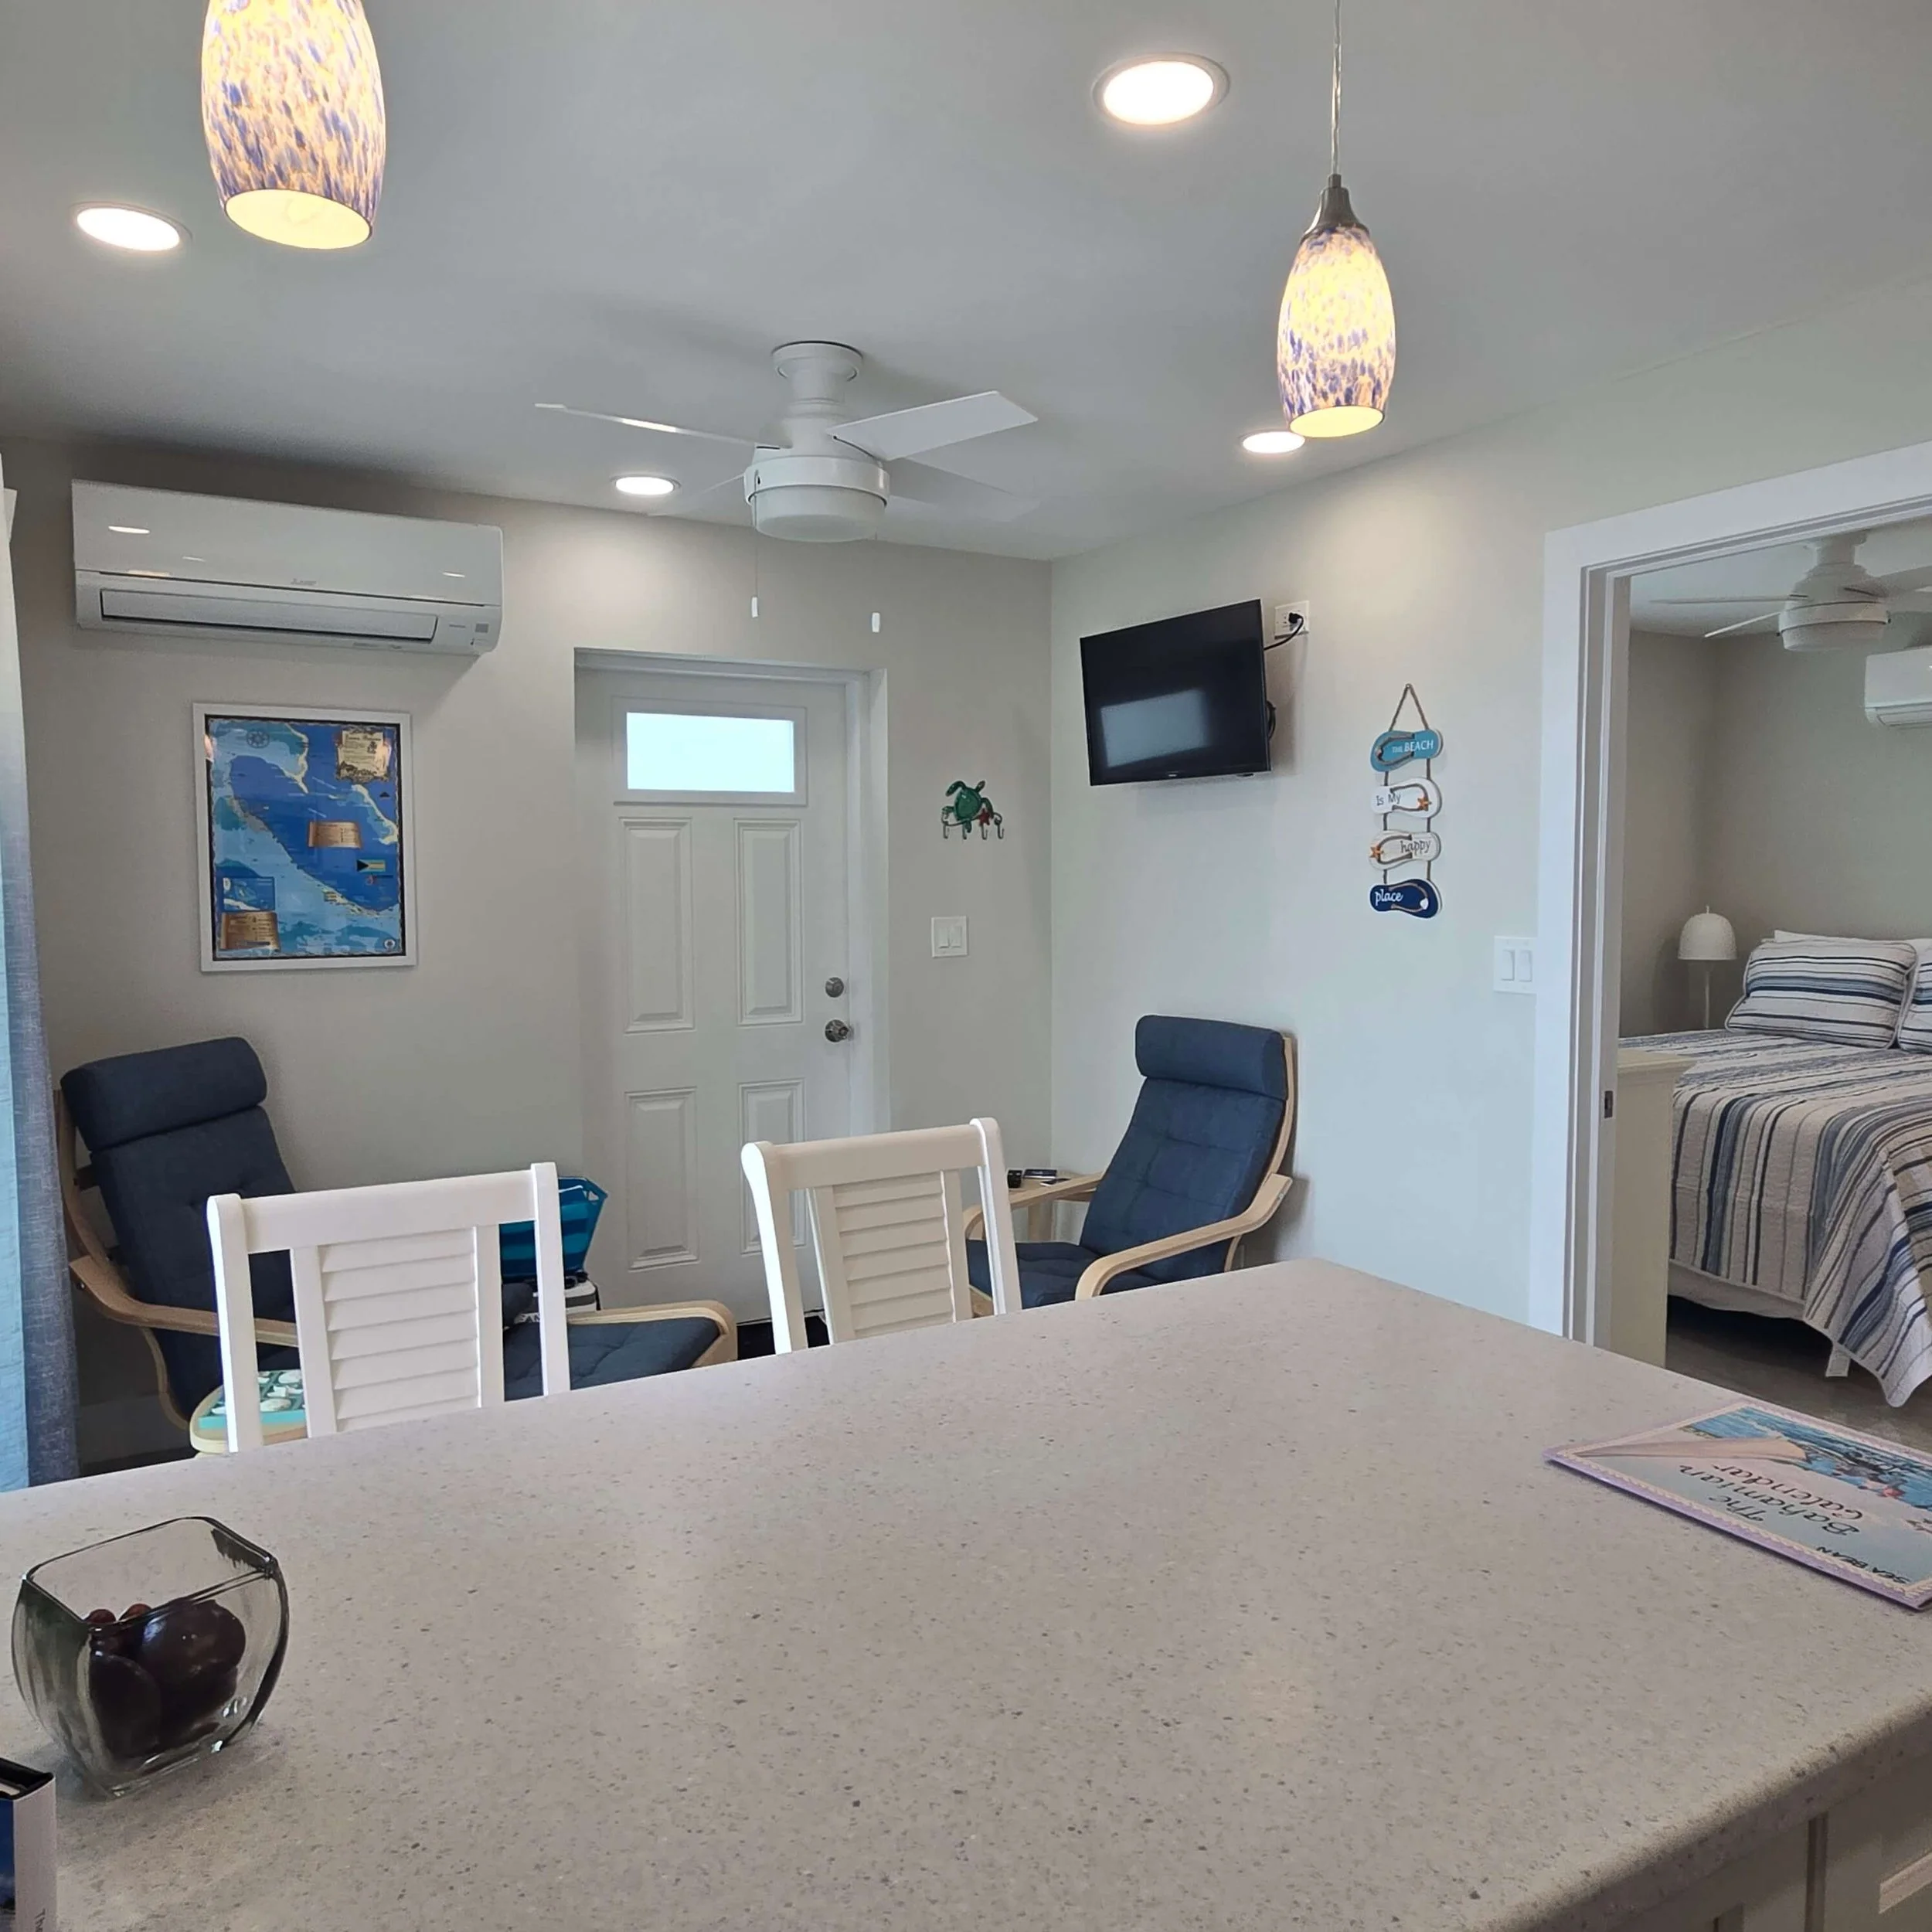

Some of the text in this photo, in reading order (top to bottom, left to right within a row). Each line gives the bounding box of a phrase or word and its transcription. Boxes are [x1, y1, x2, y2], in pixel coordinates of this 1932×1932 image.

[1404, 740, 1434, 753] BEACH
[1376, 793, 1401, 806] Is My
[1400, 839, 1431, 855] happy
[1374, 888, 1404, 906] place
[1679, 1464, 1861, 1536] Bahamian
[1711, 1463, 1863, 1521] Calendar
[1708, 1495, 1767, 1522] The
[1815, 1546, 1912, 1584] SEA BEAN
